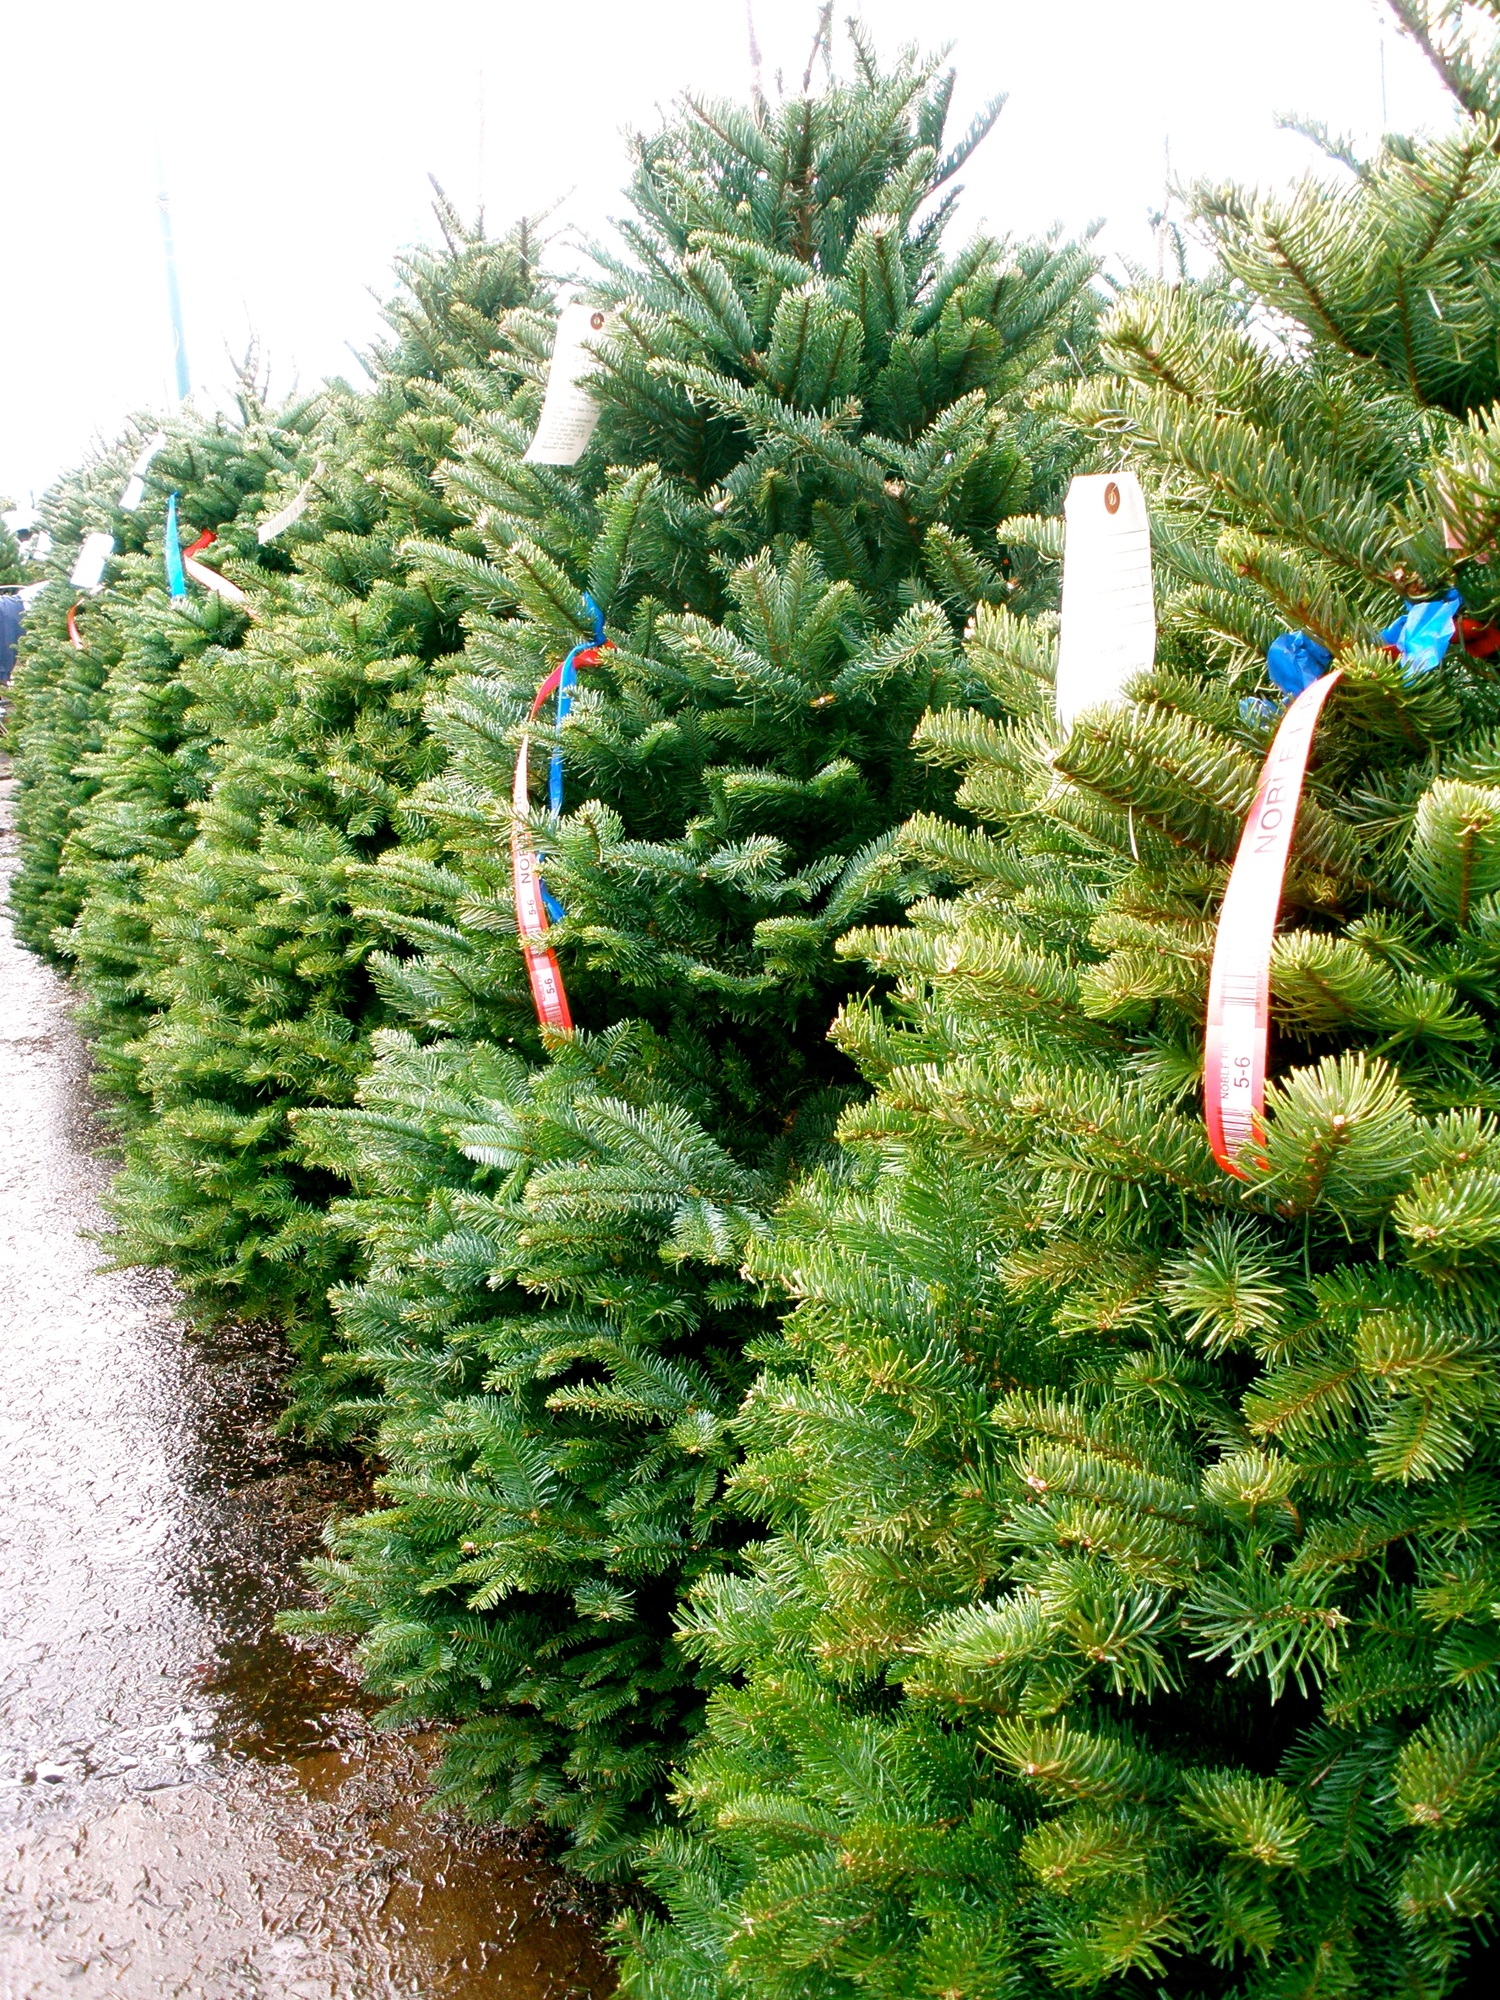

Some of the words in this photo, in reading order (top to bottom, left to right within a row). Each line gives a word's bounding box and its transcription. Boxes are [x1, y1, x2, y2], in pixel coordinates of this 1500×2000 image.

[527, 899, 537, 915] 5-6
[544, 978, 555, 994] 5-6
[1221, 1063, 1230, 1099] NOBLE
[1233, 1057, 1250, 1088] 5-6
